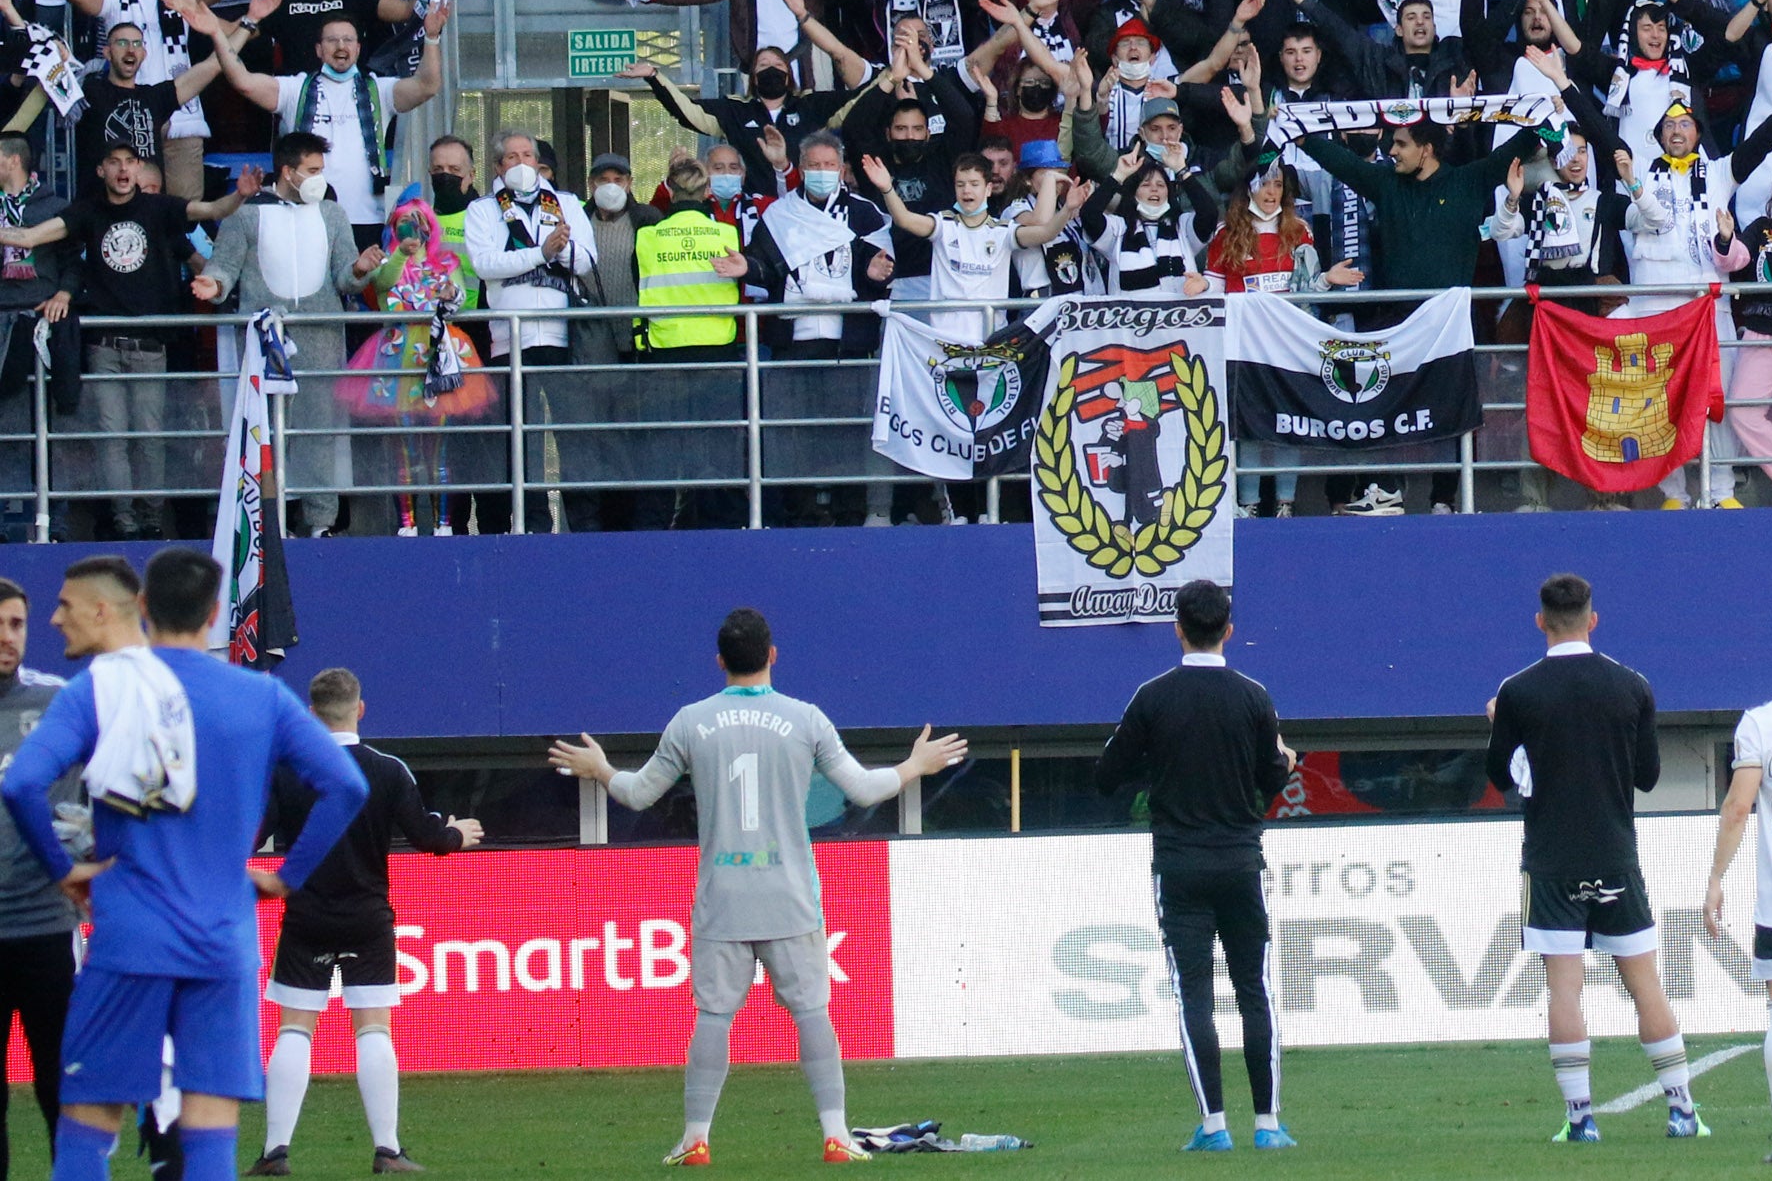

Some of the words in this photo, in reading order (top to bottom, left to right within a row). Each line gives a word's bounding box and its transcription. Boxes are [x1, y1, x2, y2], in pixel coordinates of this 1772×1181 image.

[574, 32, 632, 49] SALIDA
[575, 57, 630, 73] IRTEERA
[657, 250, 722, 263] SEGURTASUNA
[683, 239, 693, 248] 23
[1057, 300, 1216, 337] Burgos
[1339, 349, 1366, 359] CLUB
[992, 365, 1018, 416] FUTBOL
[1323, 360, 1343, 397] BURGOS
[1371, 364, 1389, 396] FUTBOL
[1275, 413, 1386, 441] BURGOS
[1393, 409, 1434, 435] C.F.
[931, 433, 986, 463] CLUB
[987, 426, 1017, 457] DE
[1070, 585, 1135, 619] Away
[696, 722, 716, 740] A.
[715, 708, 794, 738] HERRERO
[728, 752, 760, 832] 1
